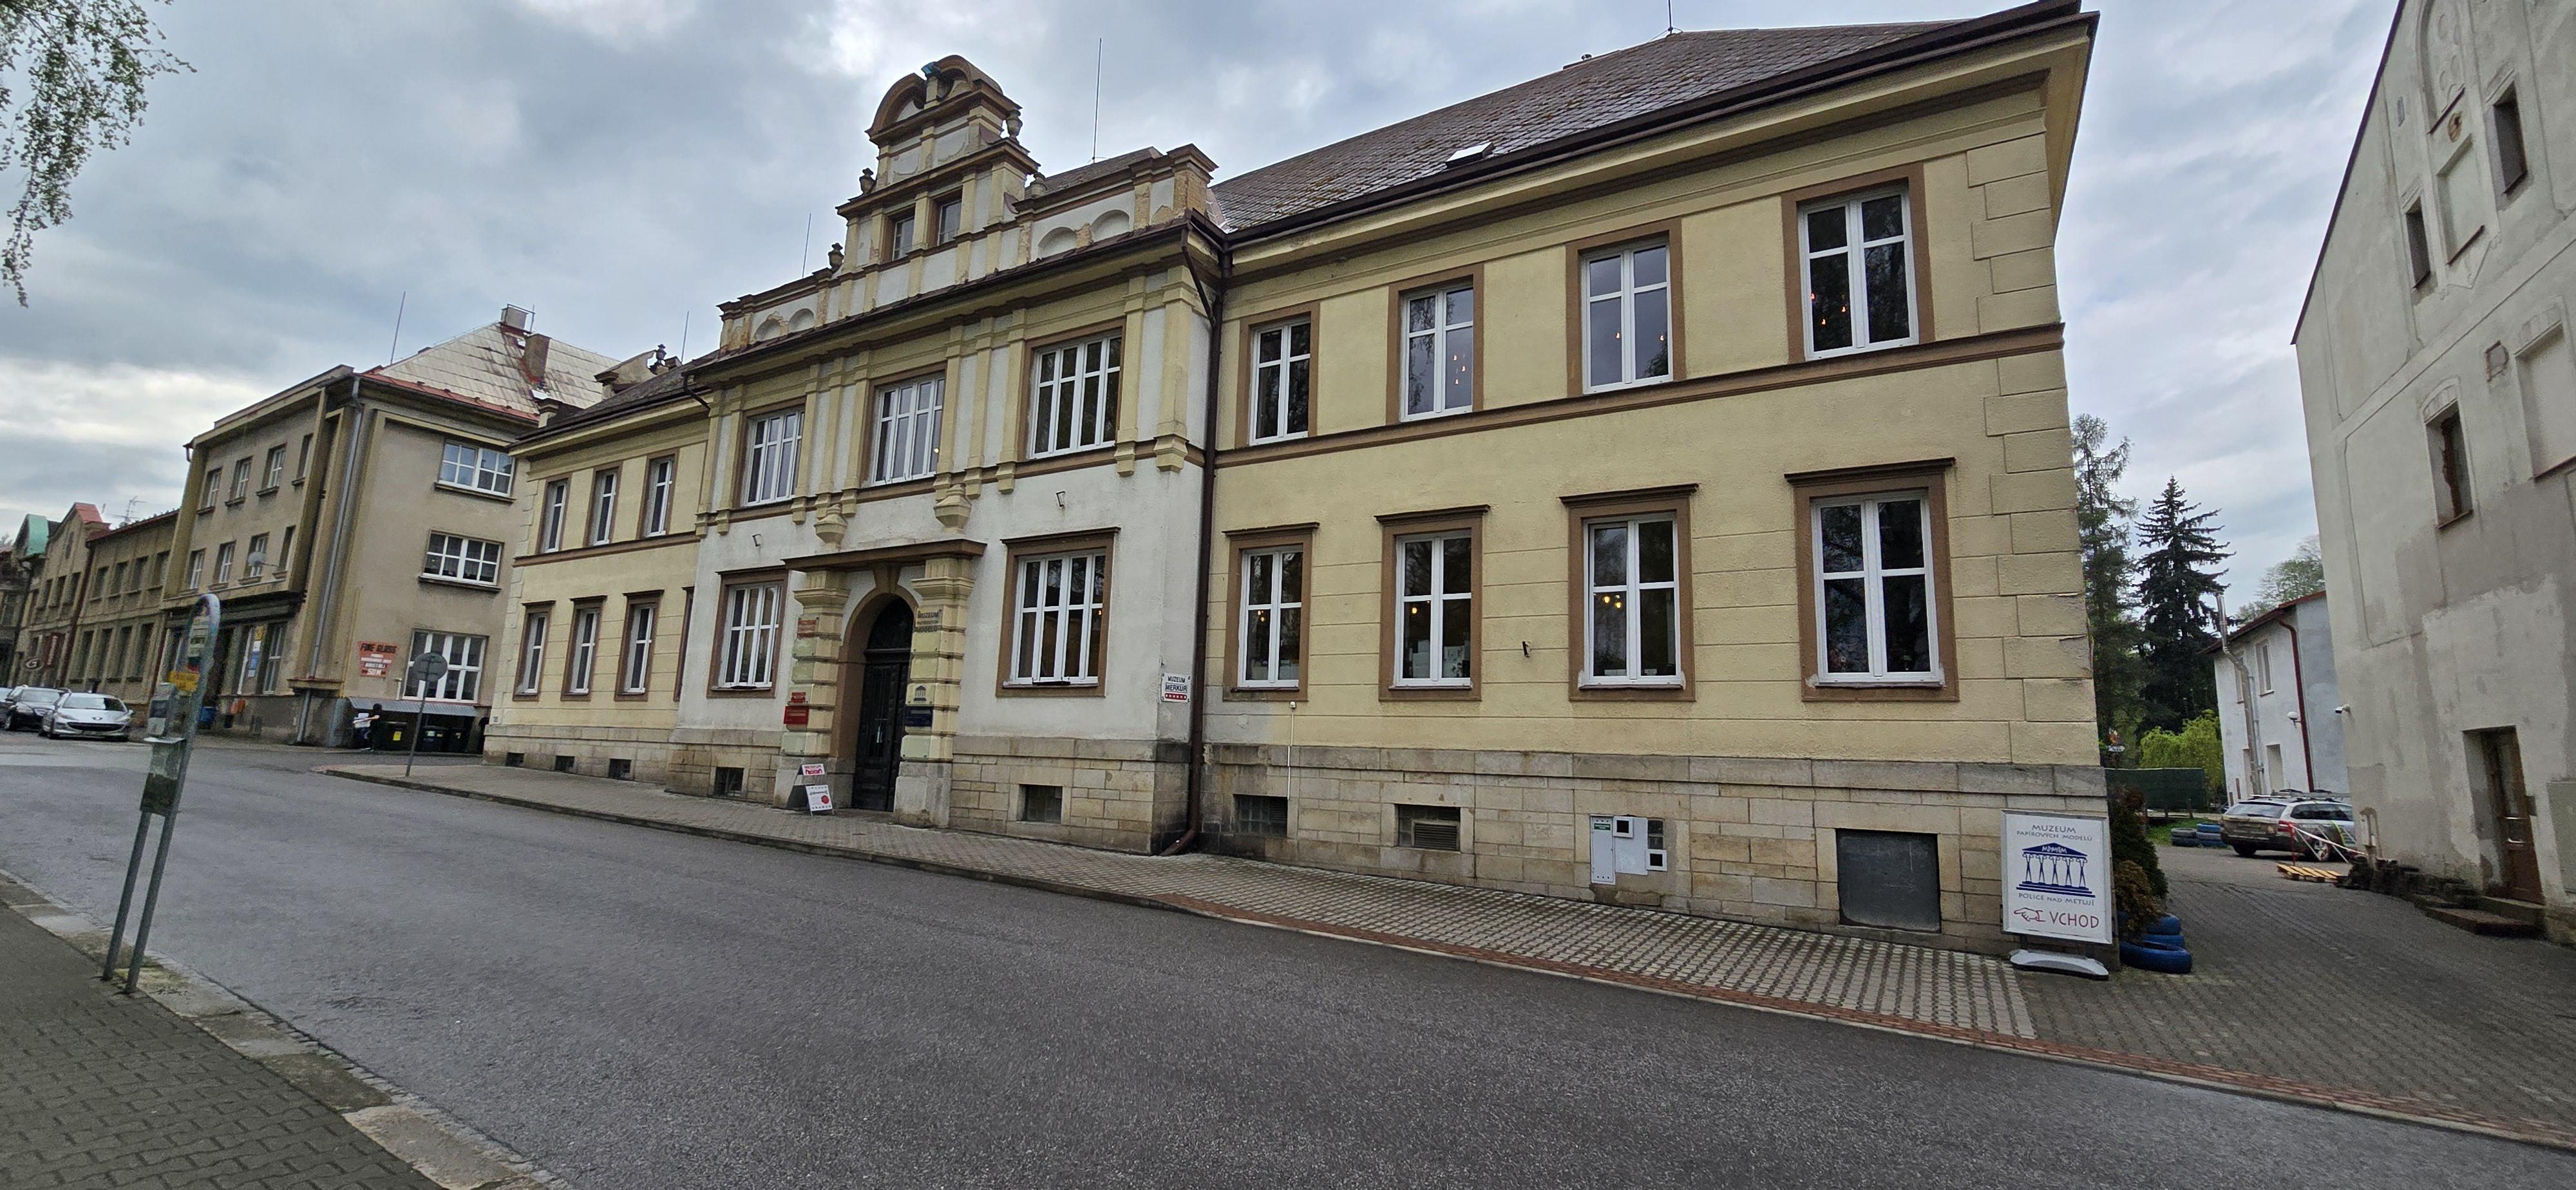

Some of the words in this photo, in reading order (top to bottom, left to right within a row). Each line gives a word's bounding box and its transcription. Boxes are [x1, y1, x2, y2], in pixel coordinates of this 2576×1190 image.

[2016, 830, 2059, 838] PAPÍROVÝCH
[2032, 824, 2076, 834] MUZEUM
[2049, 911, 2099, 929] VCHOD
